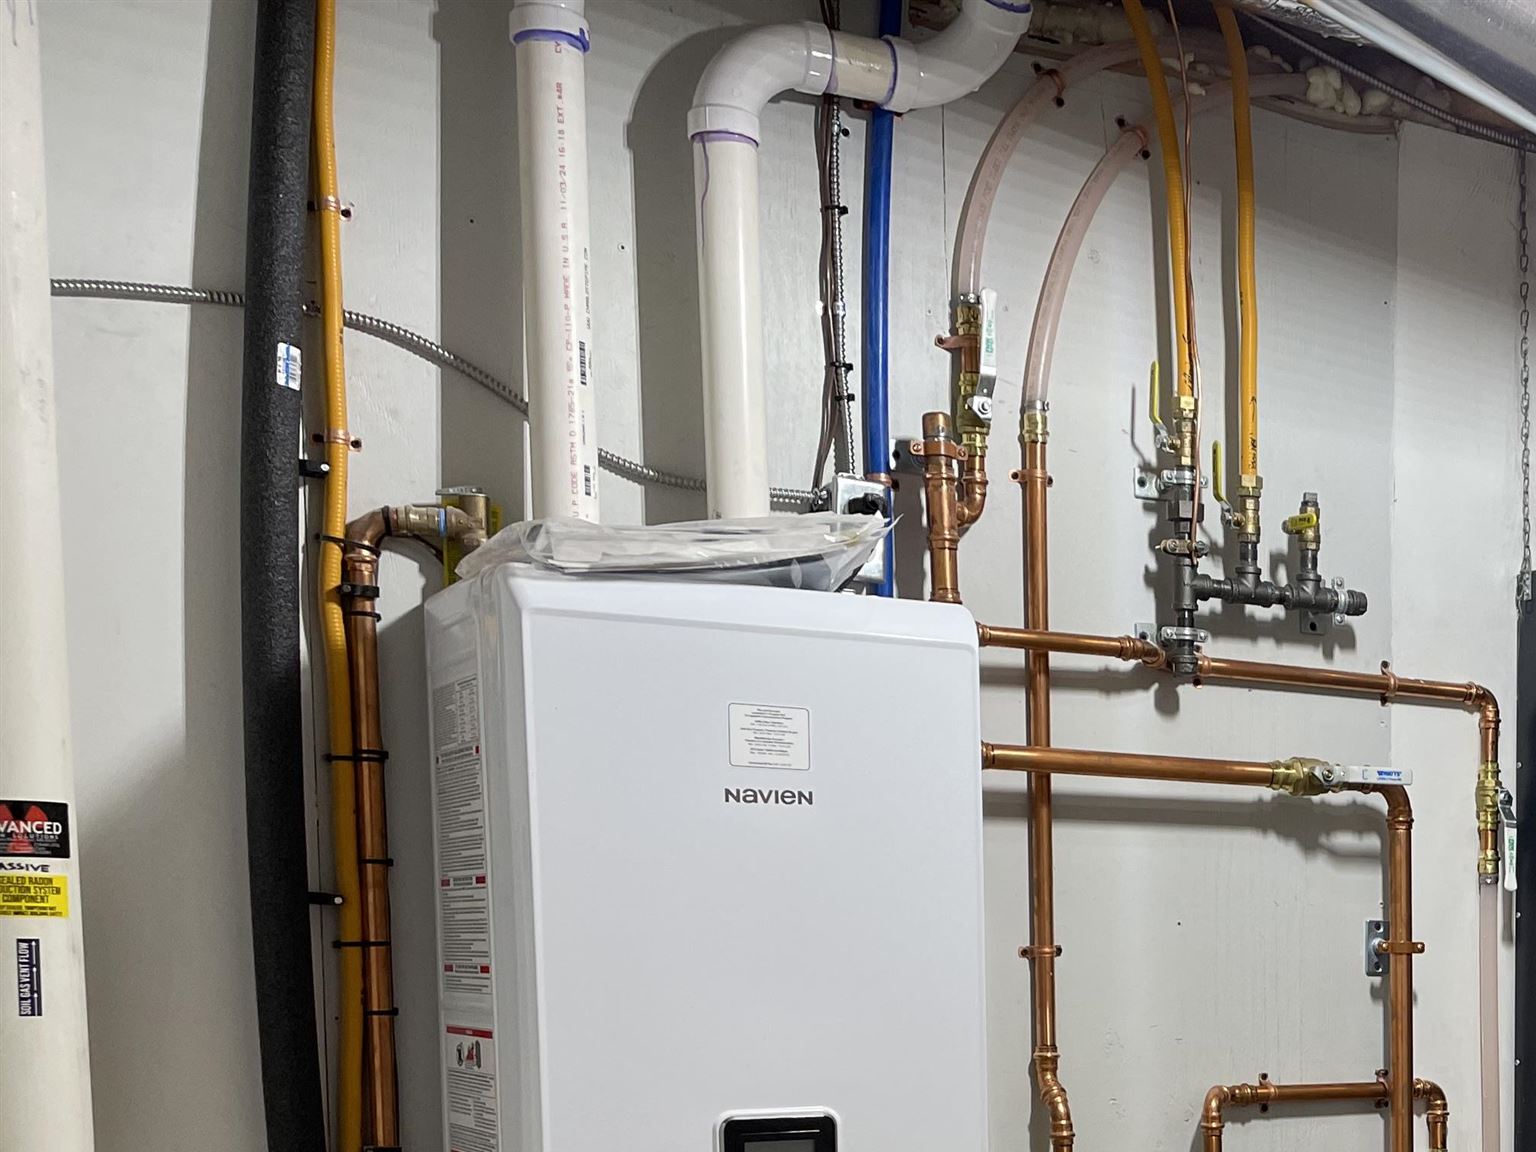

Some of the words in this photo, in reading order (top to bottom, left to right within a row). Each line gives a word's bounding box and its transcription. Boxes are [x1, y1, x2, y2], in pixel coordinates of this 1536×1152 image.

[562, 257, 569, 269] IN
[562, 275, 570, 299] MADE
[2, 894, 49, 904] COMPONENT
[33, 886, 61, 896] SYSTEM
[18, 942, 29, 962] FLOW
[19, 963, 30, 982] VENT
[20, 983, 31, 998] GAS
[20, 998, 32, 1015] SOIL
